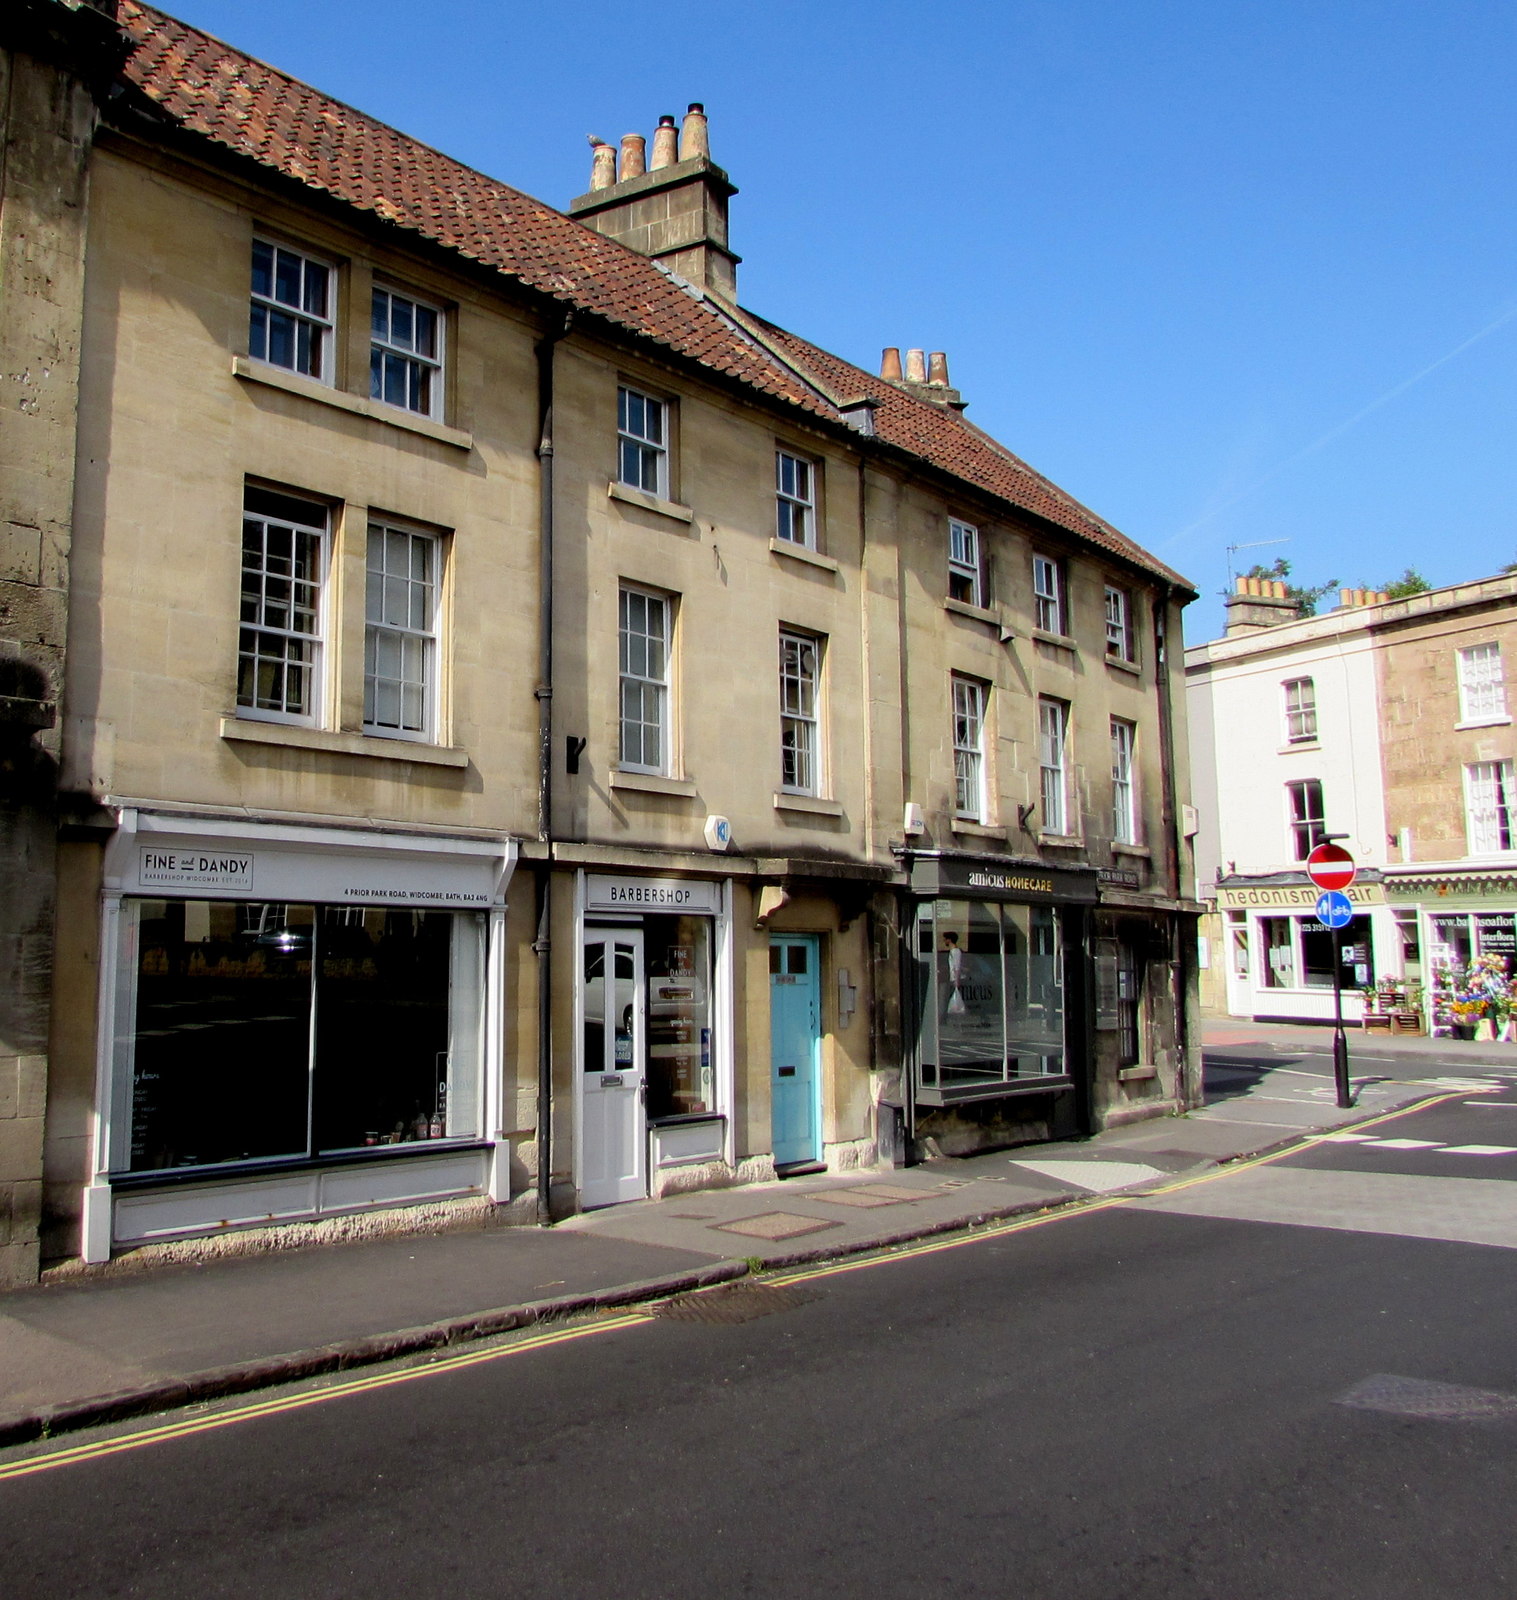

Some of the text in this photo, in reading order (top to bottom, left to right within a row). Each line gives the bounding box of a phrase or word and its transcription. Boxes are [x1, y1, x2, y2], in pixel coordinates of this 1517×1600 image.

[145, 854, 248, 874] FINE and DANDY
[144, 873, 184, 881] BARBERSHOP
[1005, 876, 1052, 892] HOMECARE
[344, 888, 488, 902] 4 PRIOR PARK ROAD, WIDCOMBE, BATH, BA2 4NG
[611, 887, 690, 903] BARBERSHOP
[1479, 930, 1514, 942] Interflora
[673, 950, 687, 958] FINE
